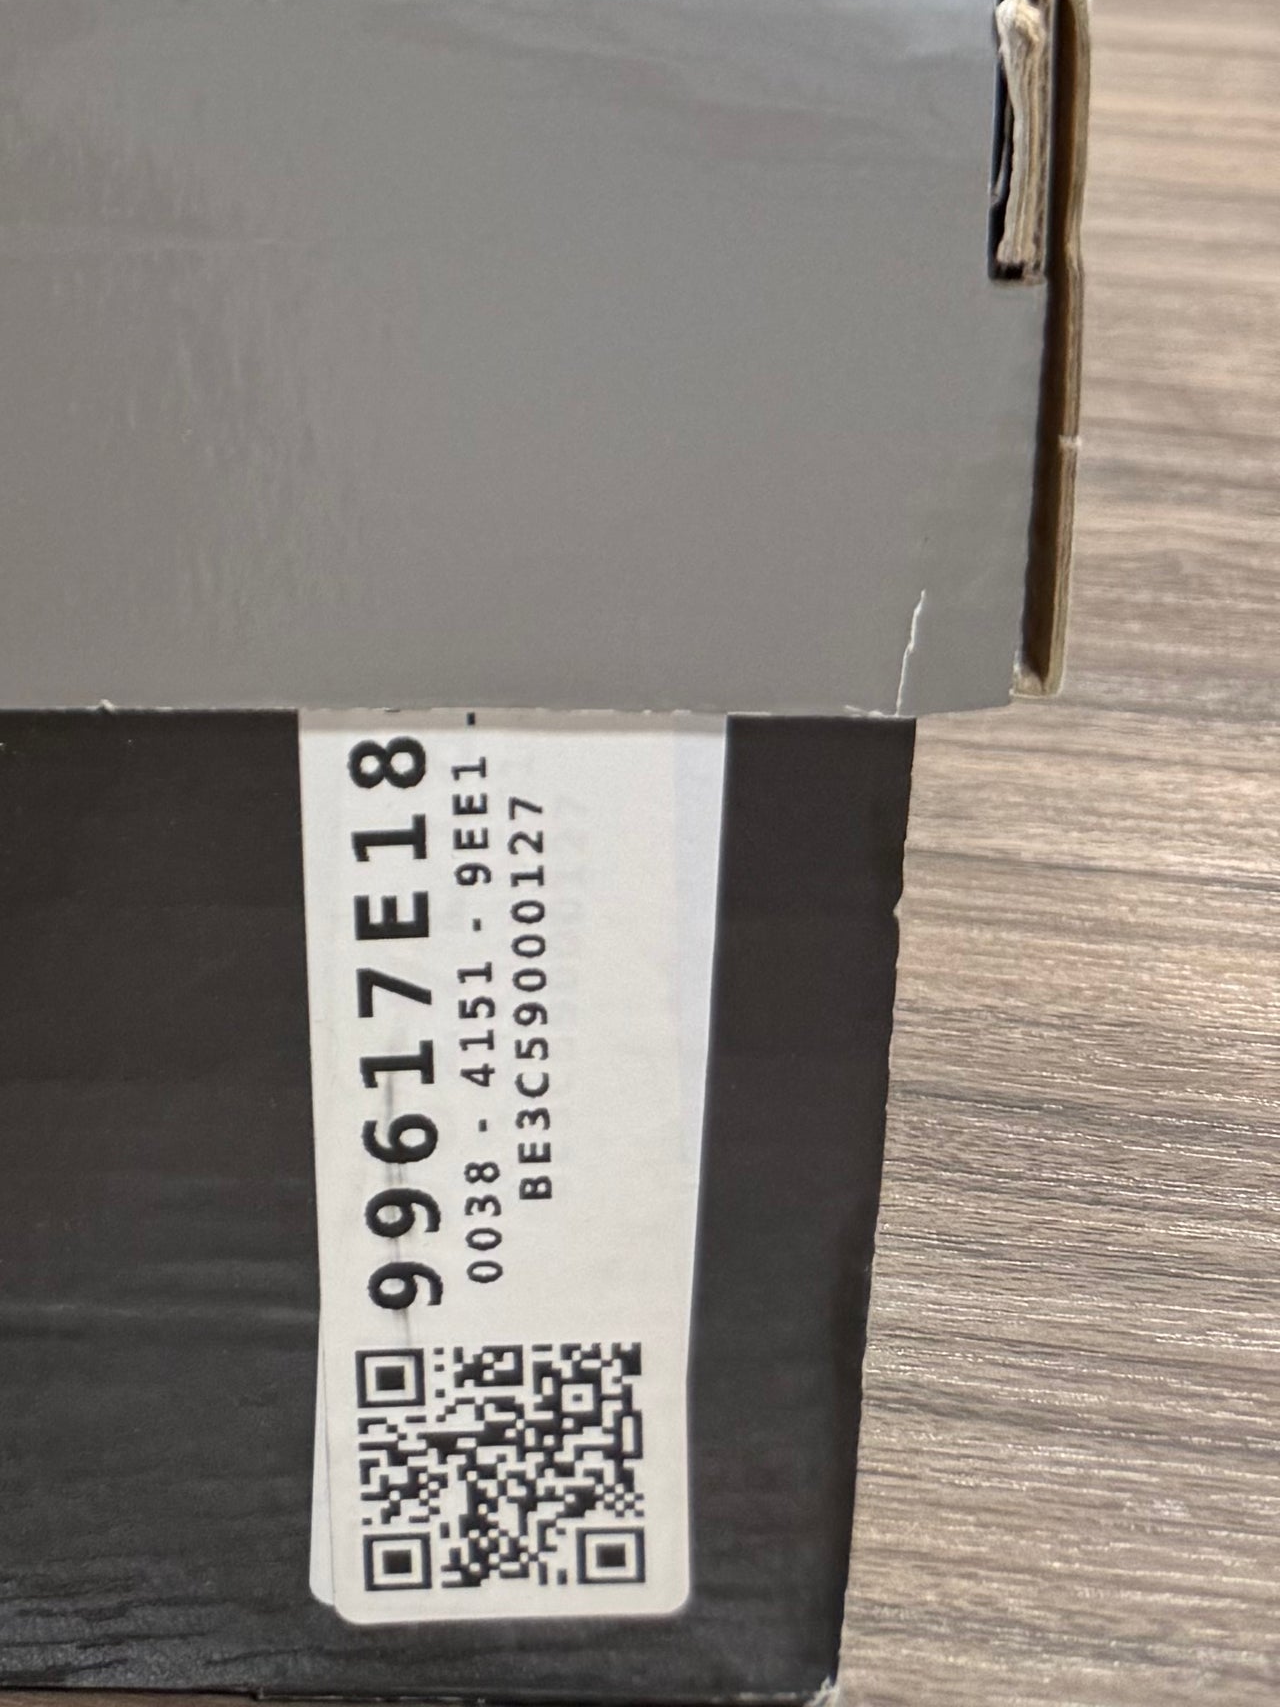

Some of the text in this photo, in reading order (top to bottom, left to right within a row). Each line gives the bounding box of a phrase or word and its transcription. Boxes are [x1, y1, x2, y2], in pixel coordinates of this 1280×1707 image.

[451, 756, 492, 887] 9EE1
[348, 736, 443, 1311] 99617E18
[457, 960, 496, 1088] 4151
[507, 796, 553, 1201] BE3C59000127
[464, 1161, 504, 1284] 0038
